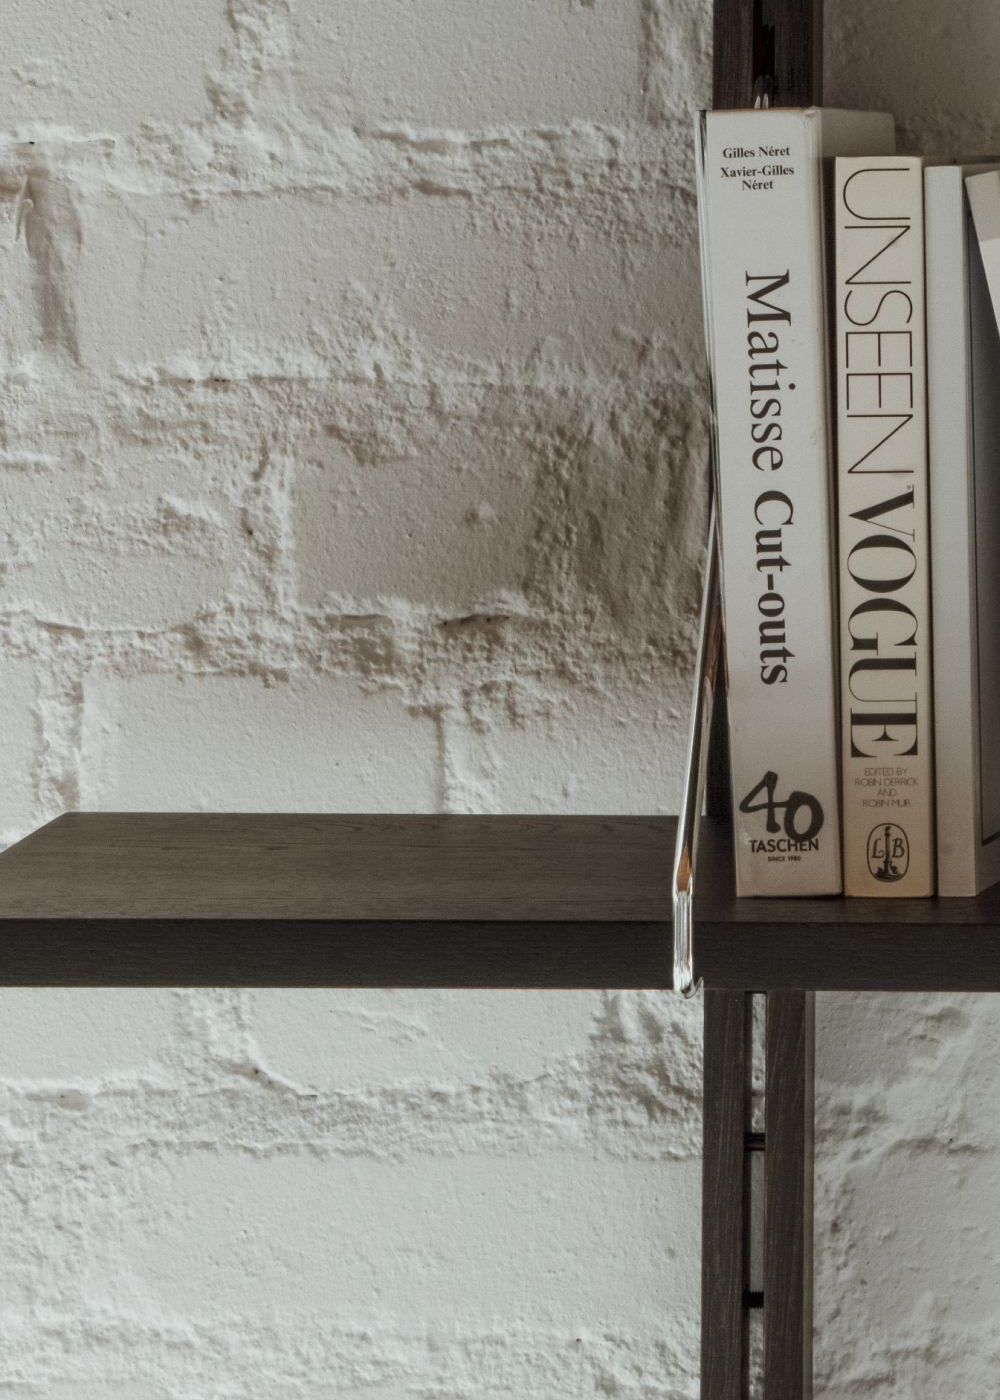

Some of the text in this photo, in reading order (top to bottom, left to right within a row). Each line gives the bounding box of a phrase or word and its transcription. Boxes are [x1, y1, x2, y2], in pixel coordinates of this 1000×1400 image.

[722, 146, 790, 159] Gilles Néret
[720, 165, 795, 178] Xavier-Gilles
[741, 179, 774, 191] Néret
[843, 167, 918, 758] UNSEEN VOGUE
[745, 268, 796, 686] Matisse Cut-outs
[864, 767, 908, 777] EDITED BY
[854, 777, 919, 787] ROBIN DERRICK
[877, 788, 897, 797] AND
[739, 770, 824, 843] 40
[862, 799, 911, 808] ROBIN MUIR
[749, 838, 819, 853] TASCHEN
